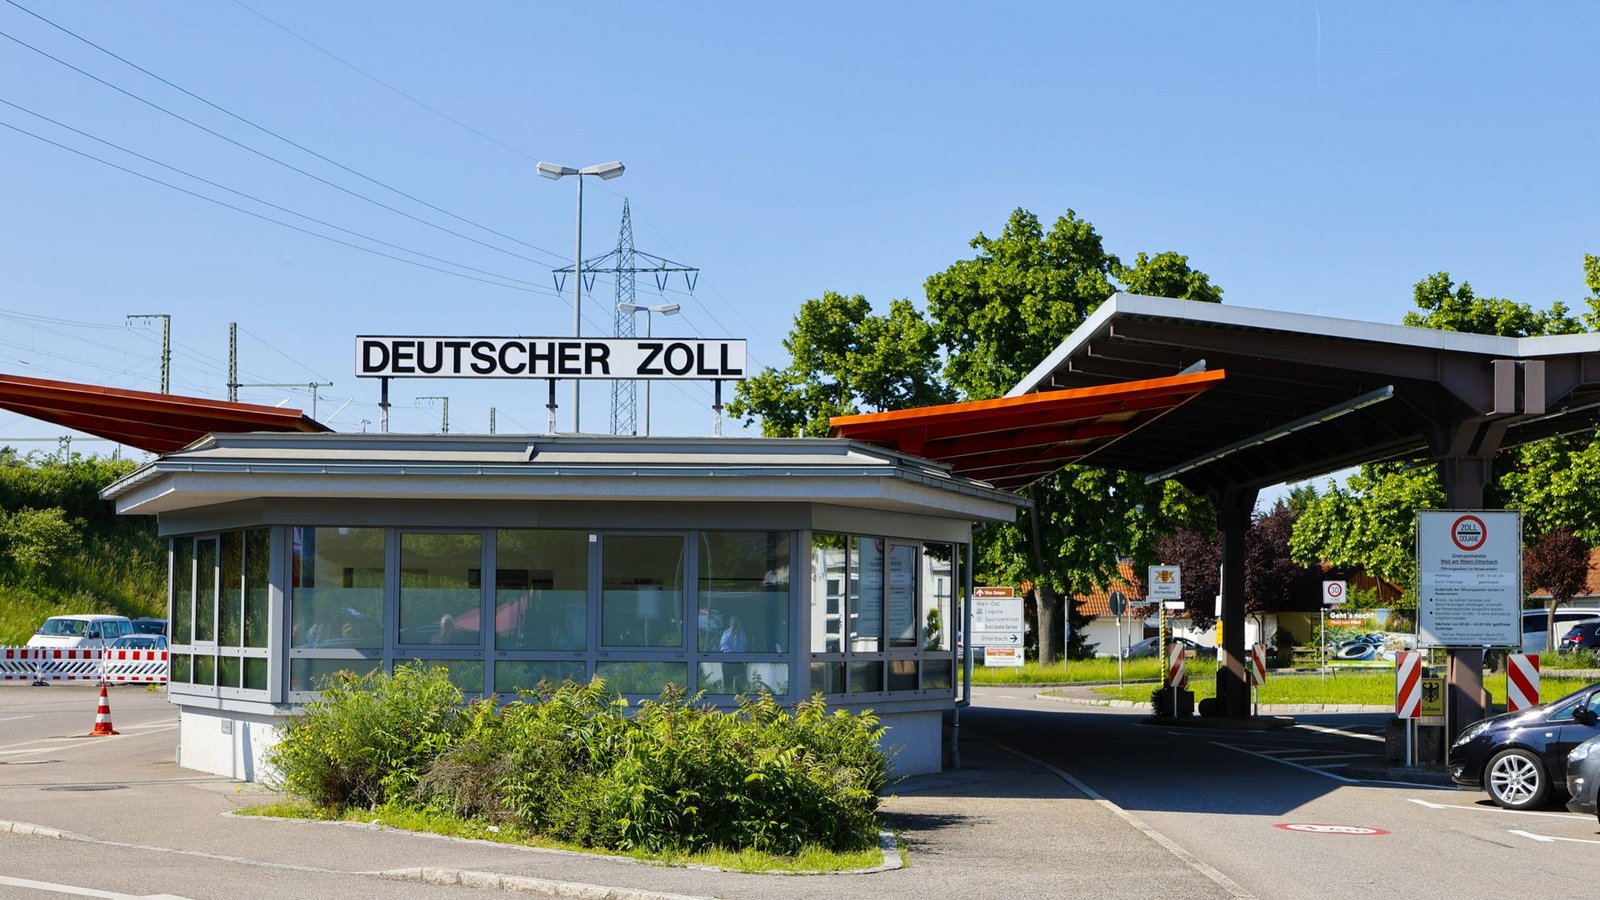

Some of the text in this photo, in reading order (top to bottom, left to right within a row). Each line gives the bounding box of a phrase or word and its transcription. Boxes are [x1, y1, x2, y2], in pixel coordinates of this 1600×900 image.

[362, 340, 743, 376] DEUTSCHER ZOLL
[1330, 586, 1340, 594] 30
[1353, 611, 1375, 619] noch?
